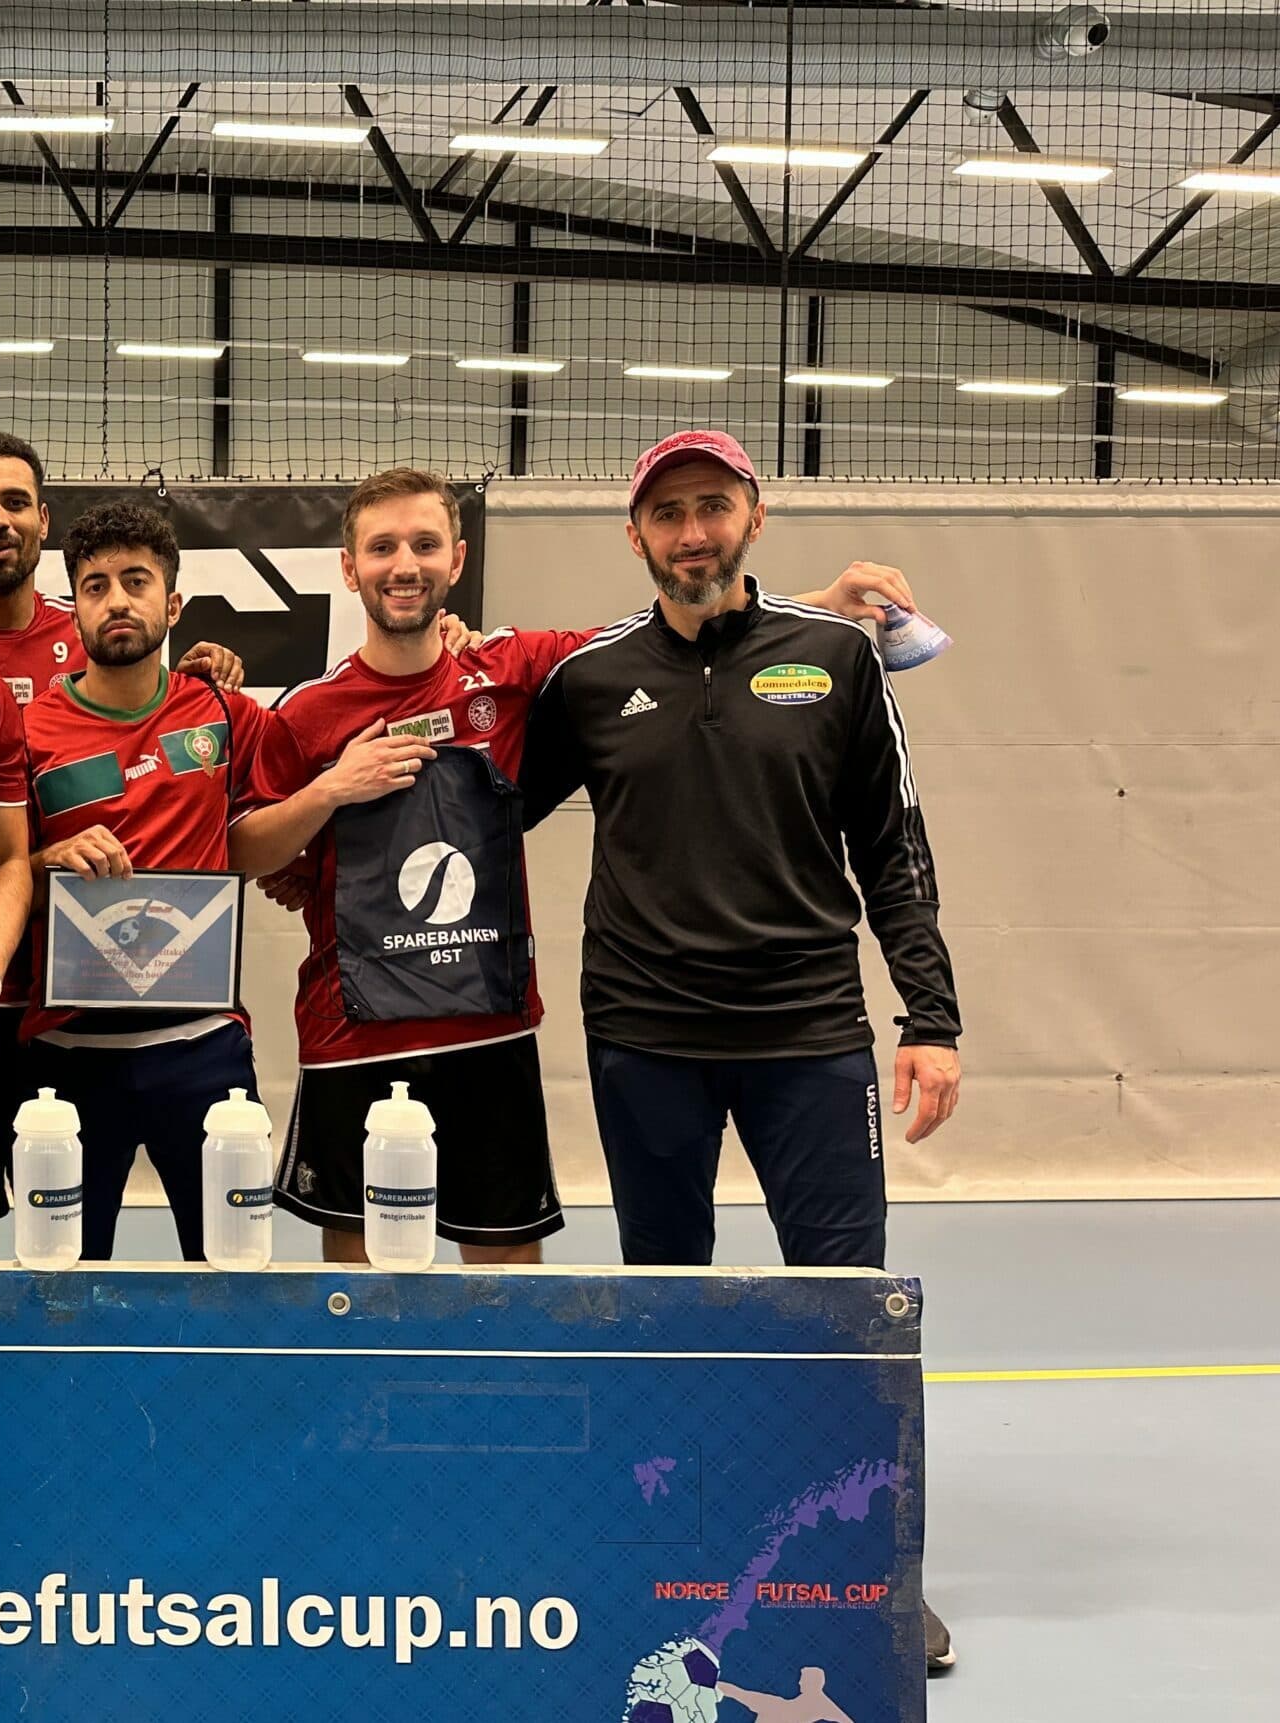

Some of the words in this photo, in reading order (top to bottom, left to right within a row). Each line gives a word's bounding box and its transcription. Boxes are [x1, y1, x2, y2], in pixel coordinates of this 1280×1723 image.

[52, 641, 69, 663] 9
[458, 670, 496, 691] 21
[755, 679, 829, 689] Lommedalens
[620, 701, 659, 717] adidas
[431, 714, 450, 726] mini
[433, 724, 449, 736] pris
[124, 758, 158, 781] PUMA
[383, 928, 499, 950] SPAREBANKEN
[430, 948, 463, 965] ØST
[866, 1084, 880, 1159] macron
[375, 1192, 426, 1202] SPAREBANKEN
[654, 1582, 729, 1600] NORGE
[756, 1582, 839, 1602] FUTSAL
[845, 1583, 889, 1602] CUP
